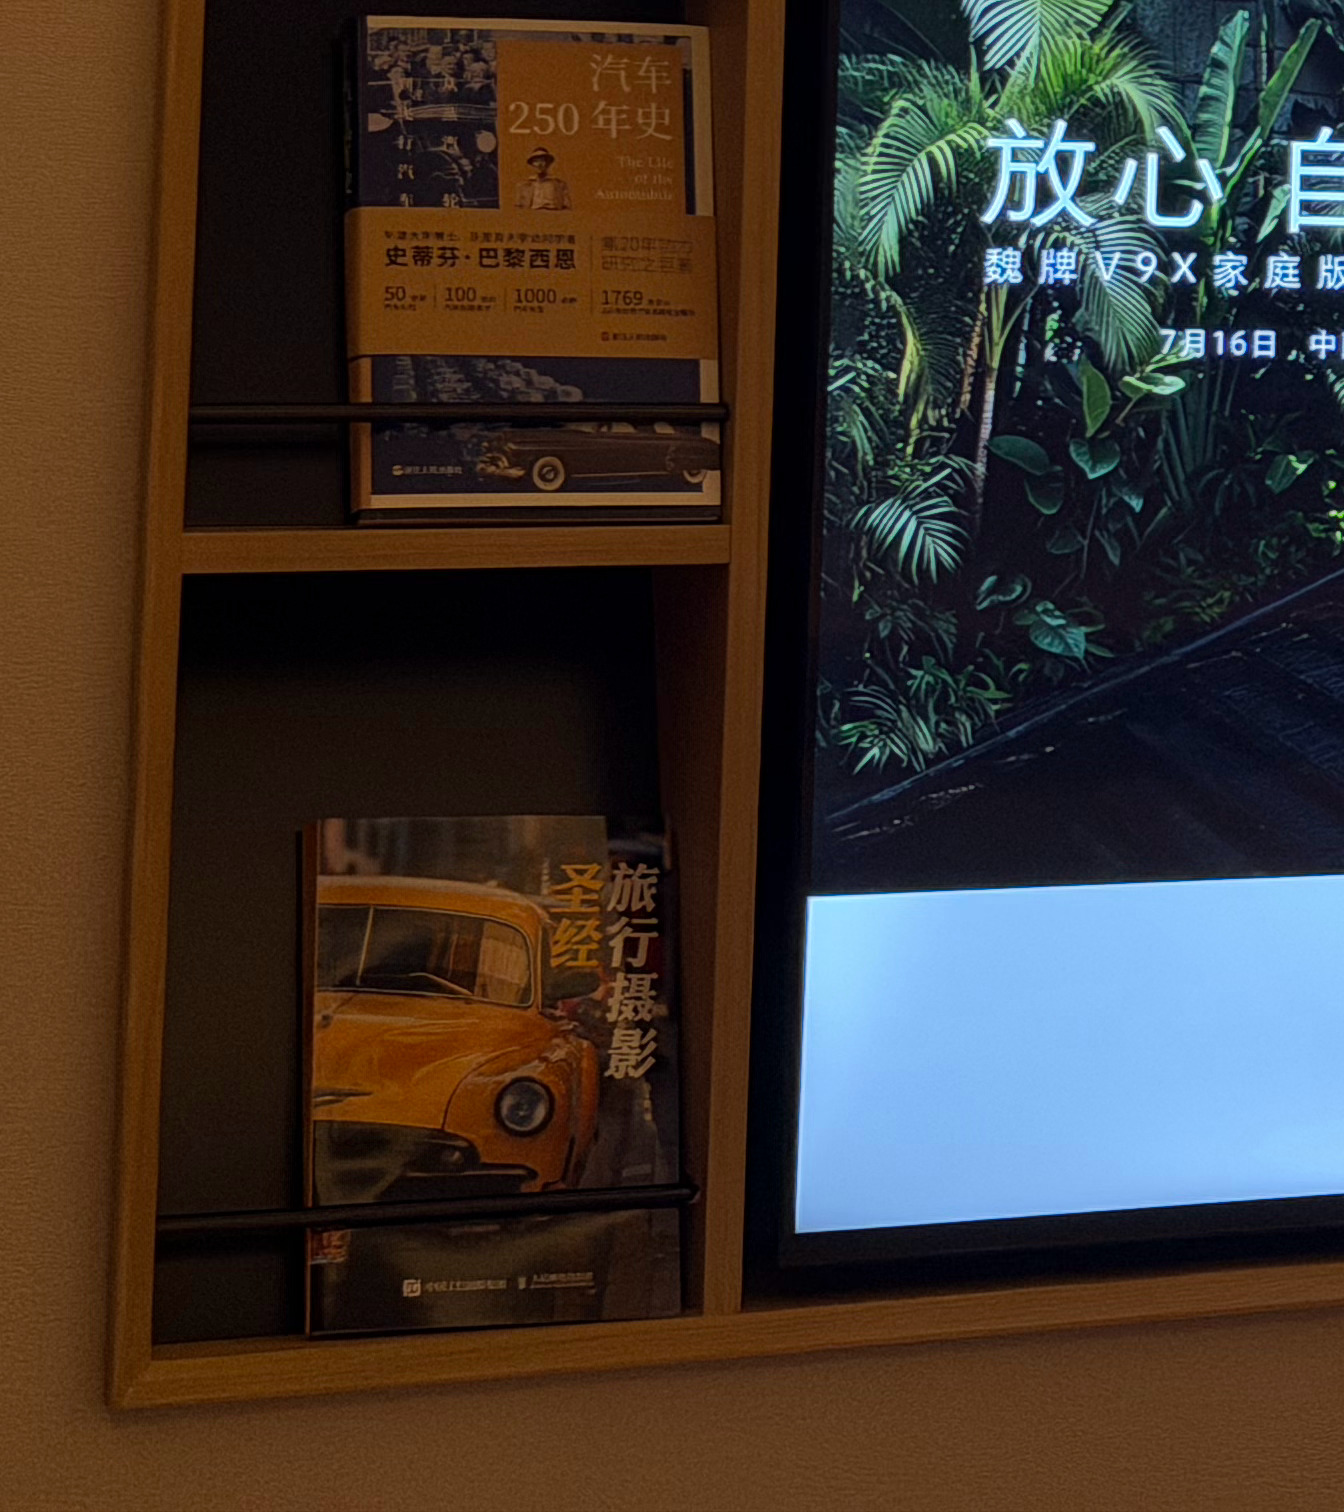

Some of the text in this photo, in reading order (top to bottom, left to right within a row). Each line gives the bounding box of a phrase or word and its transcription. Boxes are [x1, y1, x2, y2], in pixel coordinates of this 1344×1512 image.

[590, 53, 672, 94] 汽车
[508, 100, 673, 141] 250 年史
[385, 245, 576, 270] 史蒂芬·巴黎西恩
[384, 286, 406, 302] 50
[445, 287, 477, 303] 100
[514, 288, 557, 305] 1000
[601, 289, 644, 306] 1769
[1160, 328, 1276, 360] 7月16日
[548, 863, 605, 968] 圣经
[603, 861, 661, 1081] 旅行摄影
